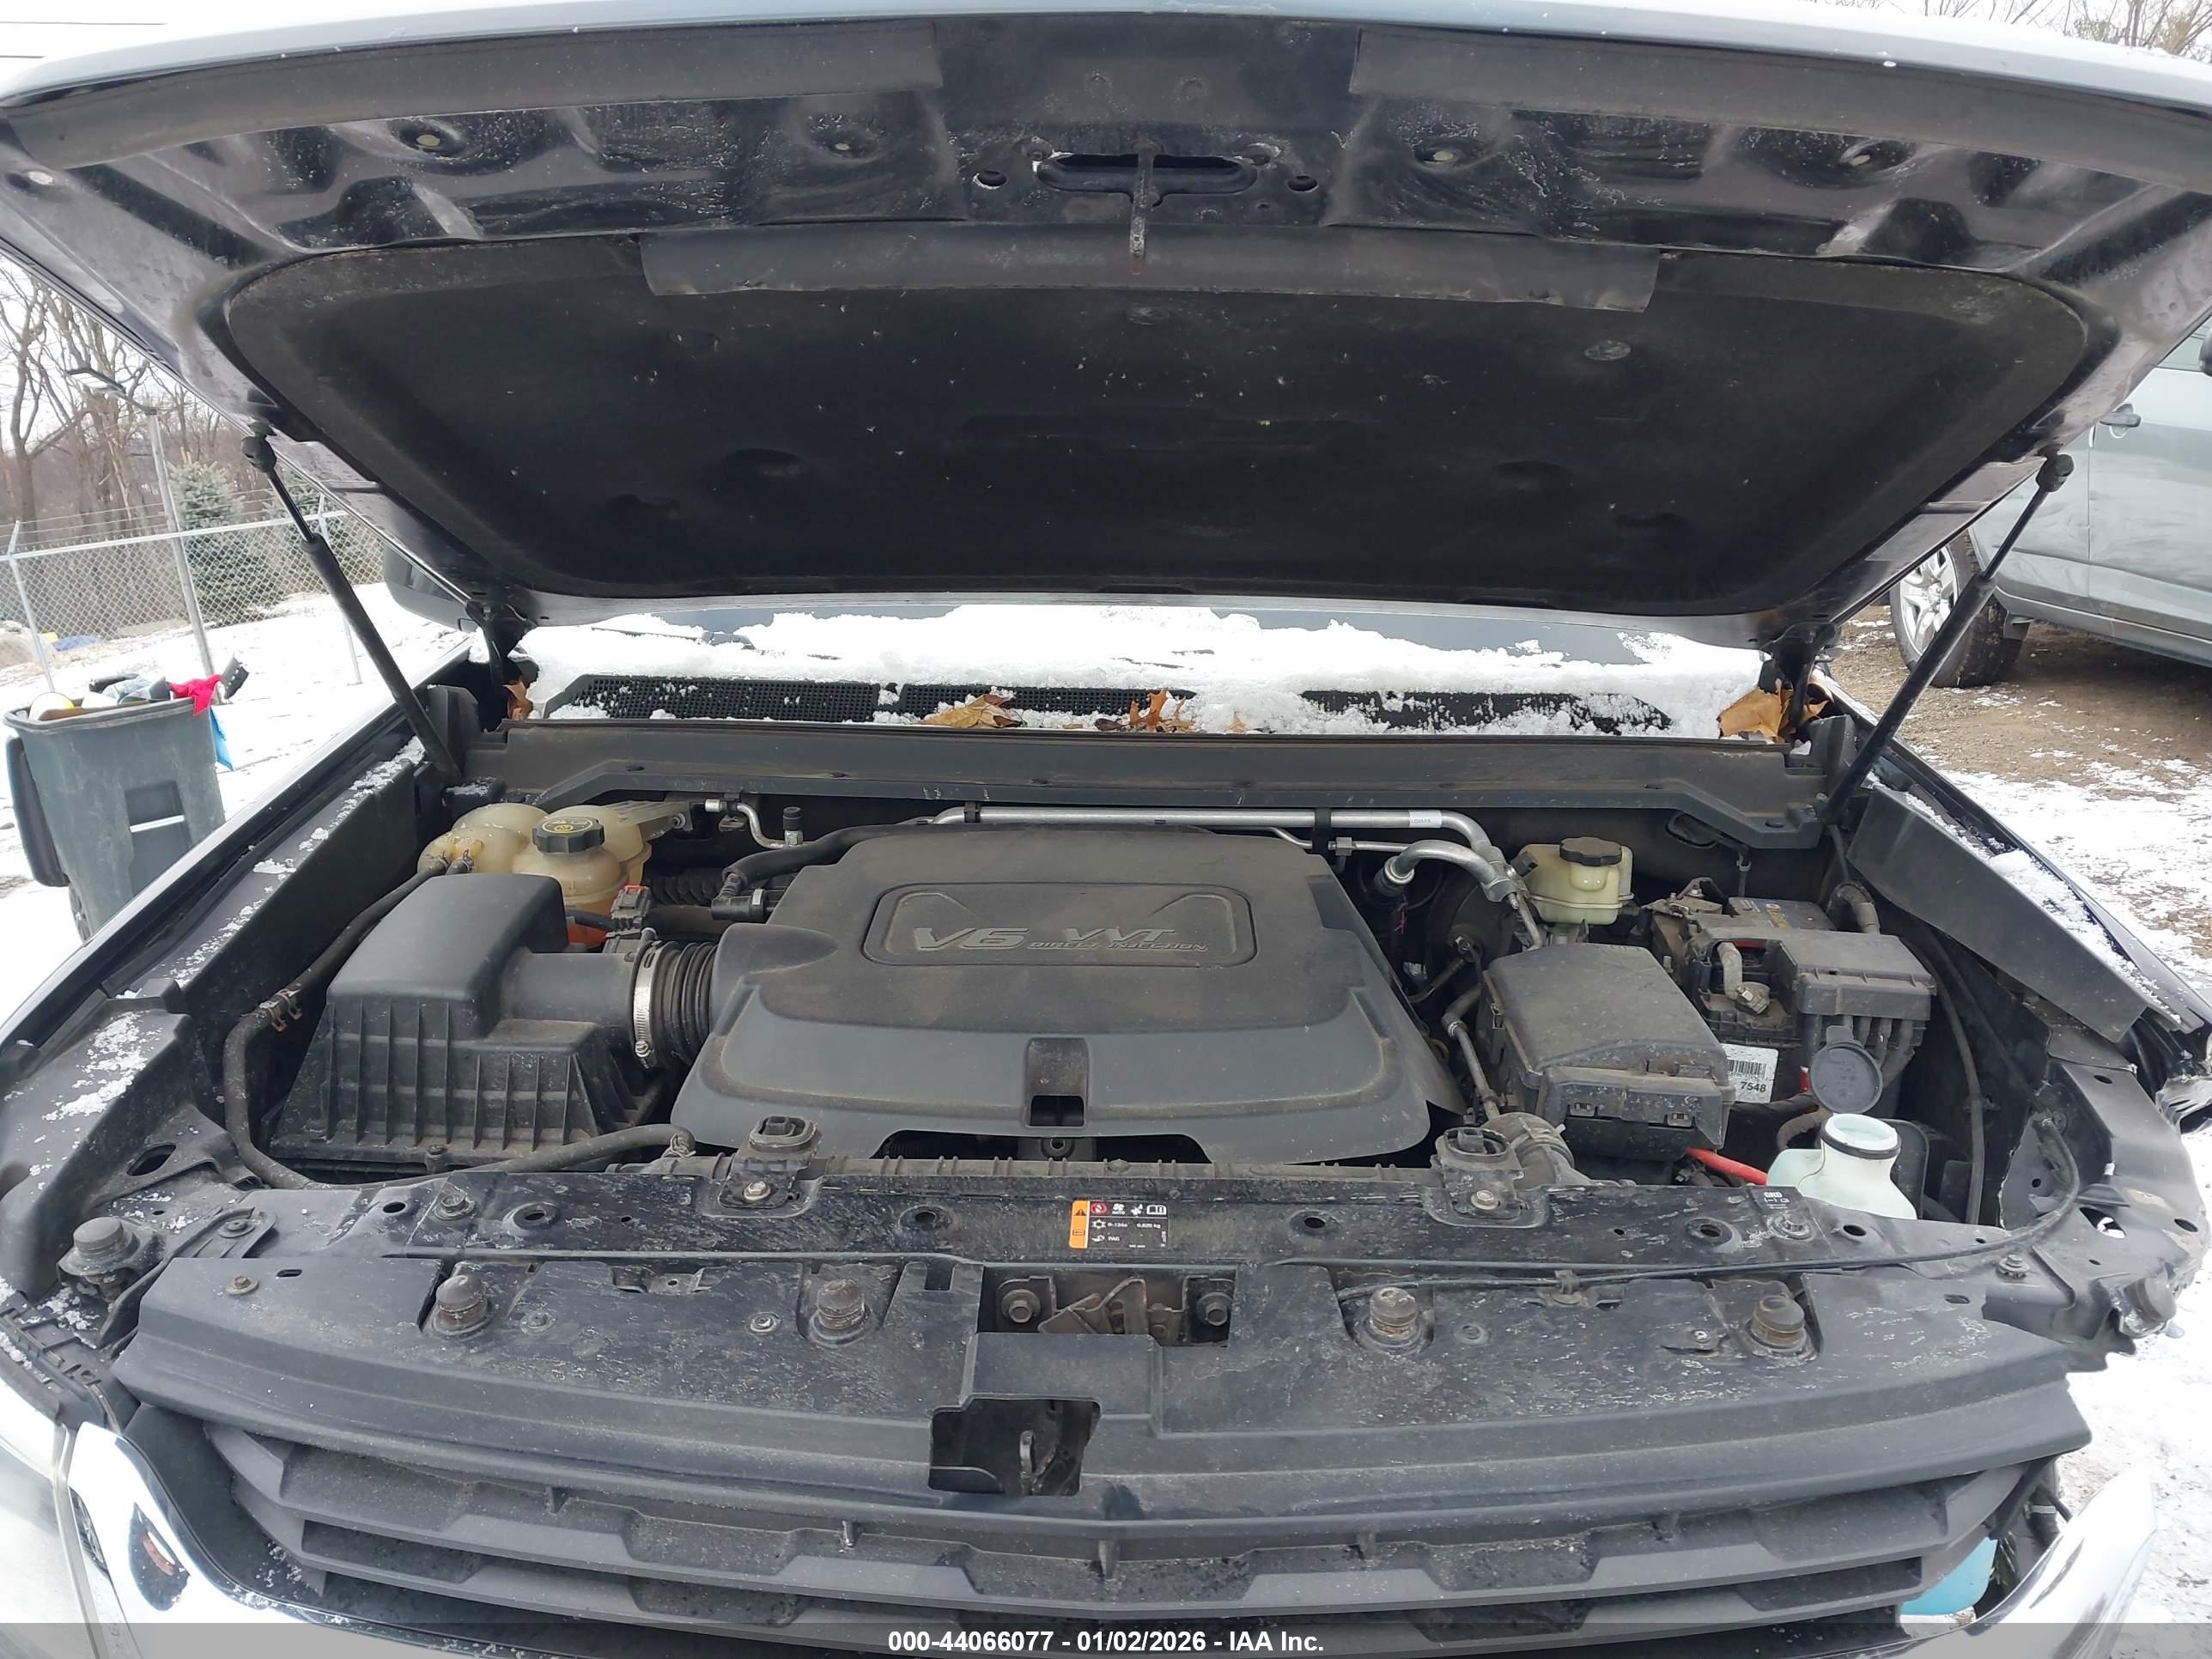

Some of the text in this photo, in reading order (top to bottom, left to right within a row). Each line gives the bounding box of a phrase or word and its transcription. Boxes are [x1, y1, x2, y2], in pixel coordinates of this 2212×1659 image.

[913, 927, 1176, 951] V6 VVT
[1028, 941, 1209, 953] DIRECT INJECTION
[1741, 1081, 1766, 1093] 7548
